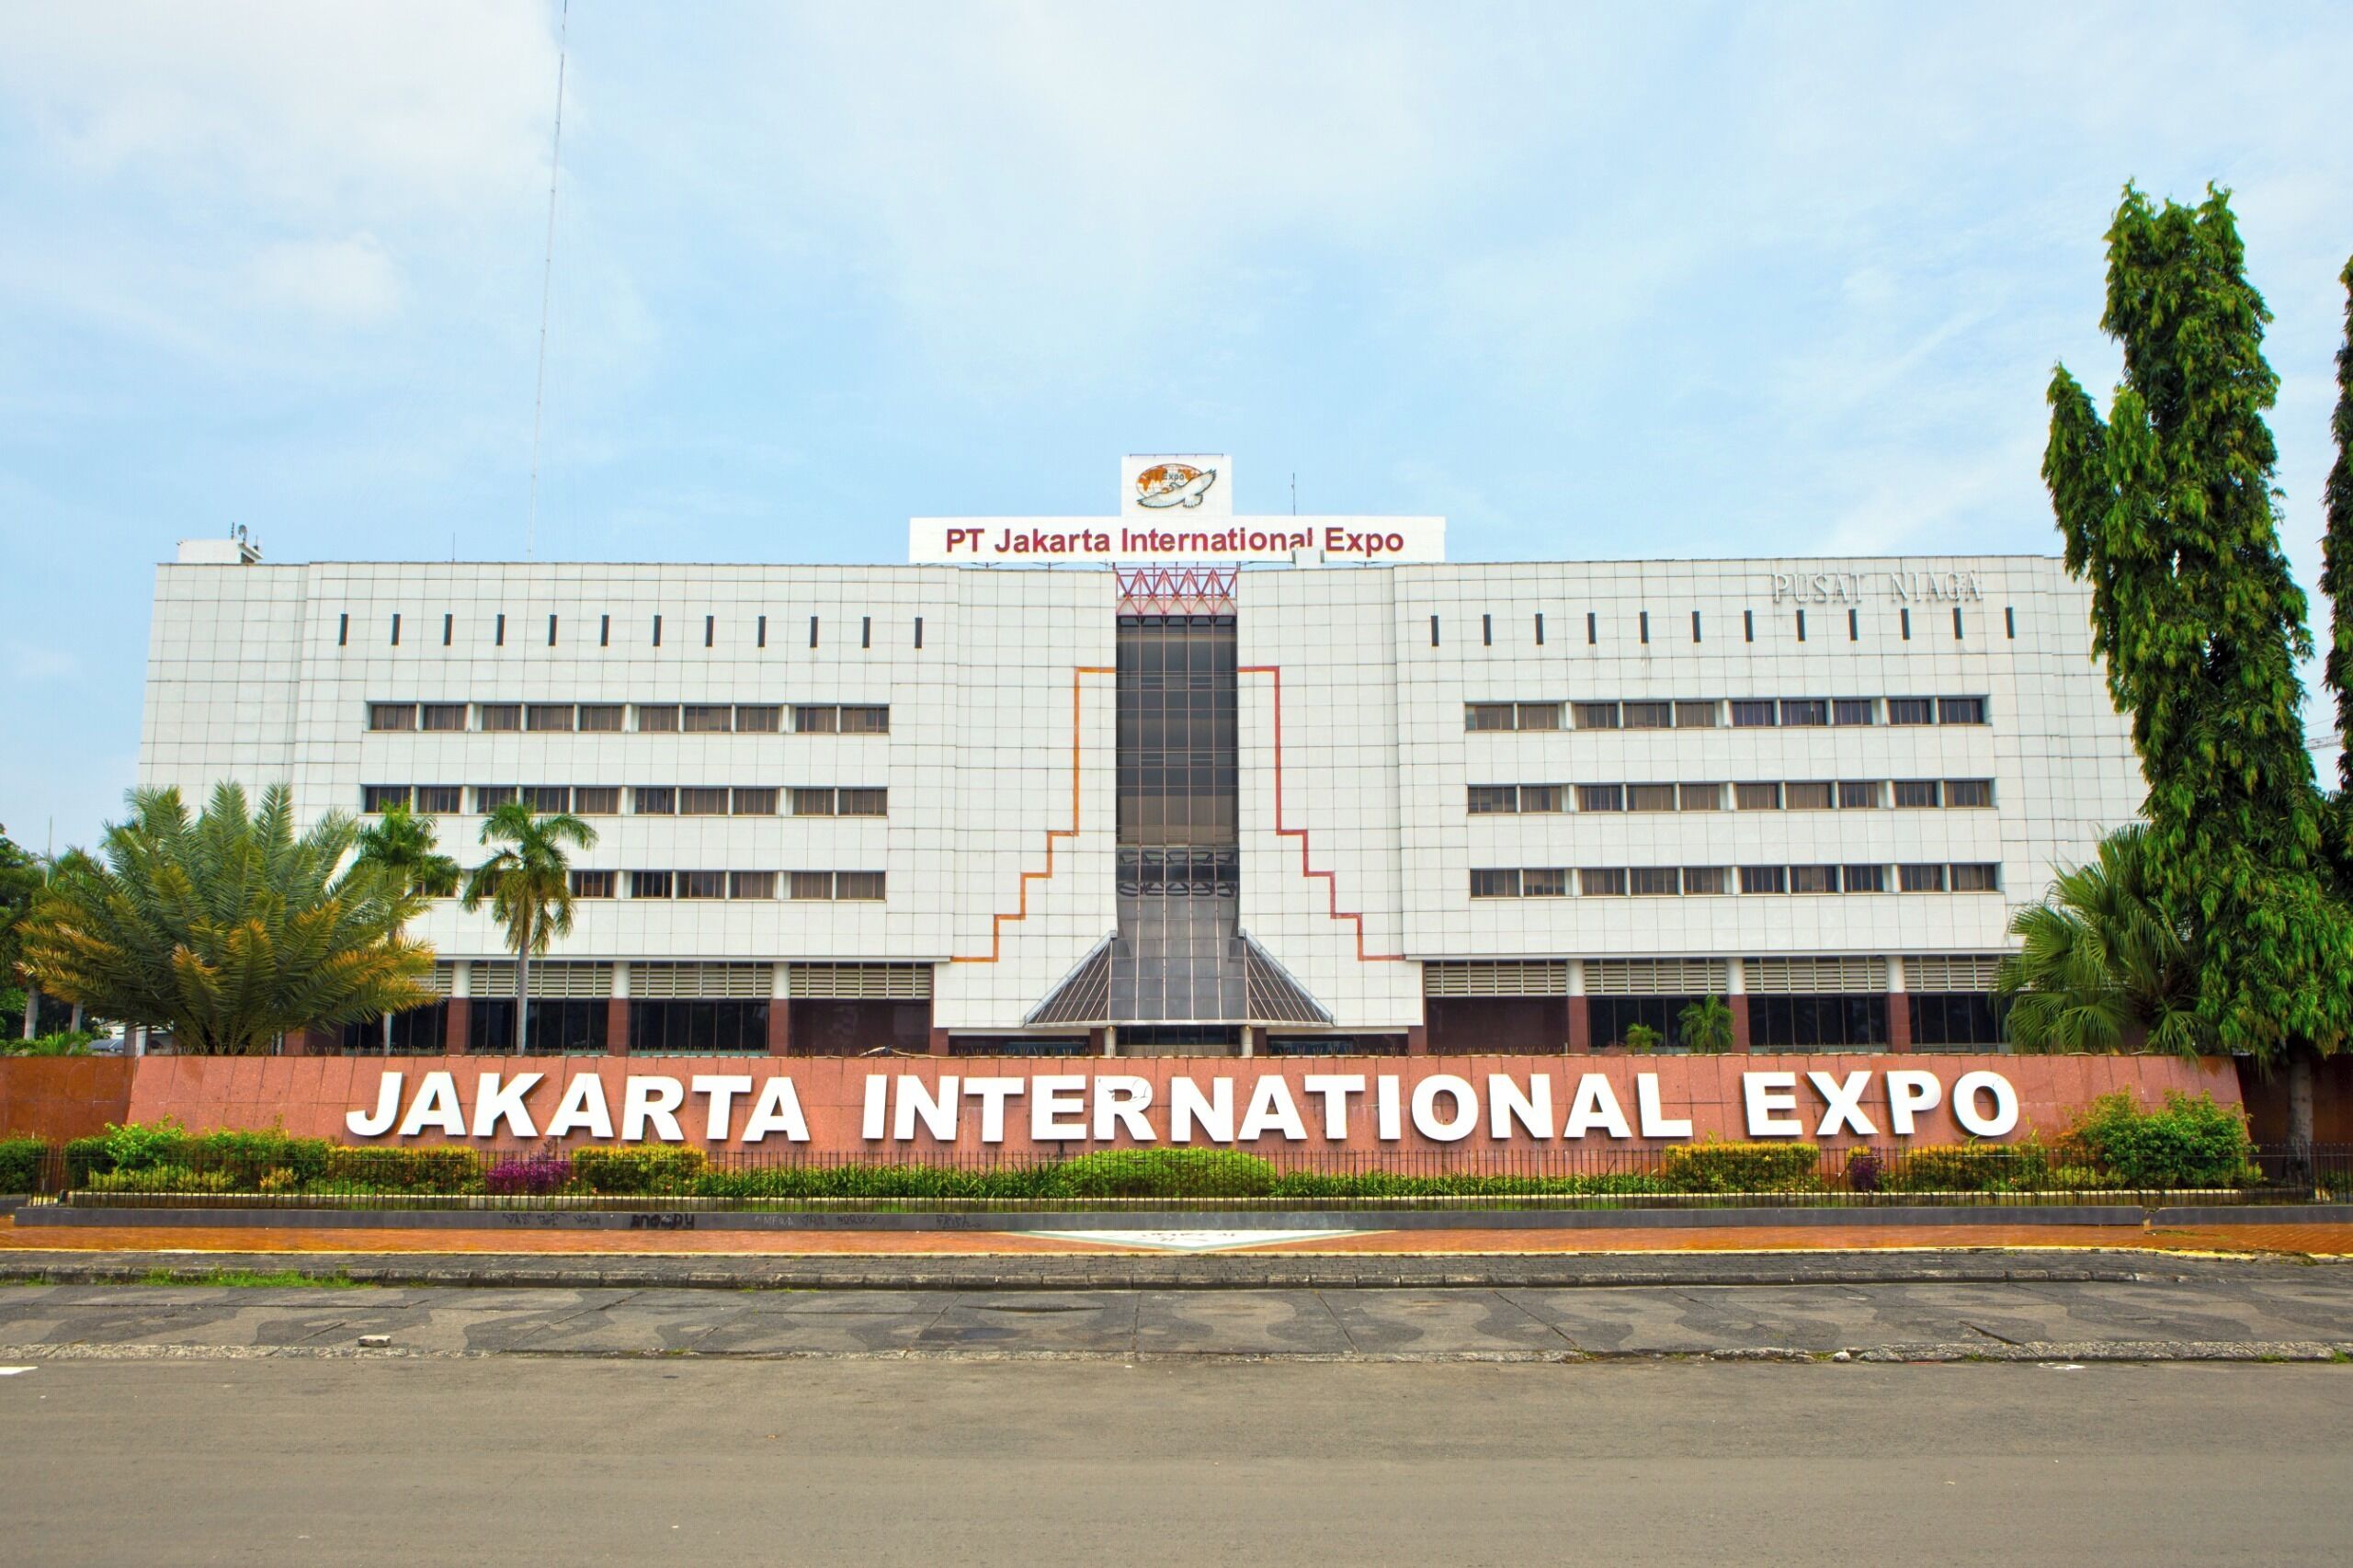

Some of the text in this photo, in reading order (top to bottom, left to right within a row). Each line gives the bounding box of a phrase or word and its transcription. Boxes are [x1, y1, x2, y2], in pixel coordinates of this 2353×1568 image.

[1162, 472, 1185, 482] Expo
[945, 527, 1404, 557] PT Jakarta International Expo
[1772, 570, 1984, 604] PUSAT NIAGA
[346, 1069, 2020, 1143] JAKARTA INTERNATIONAL EXPO
